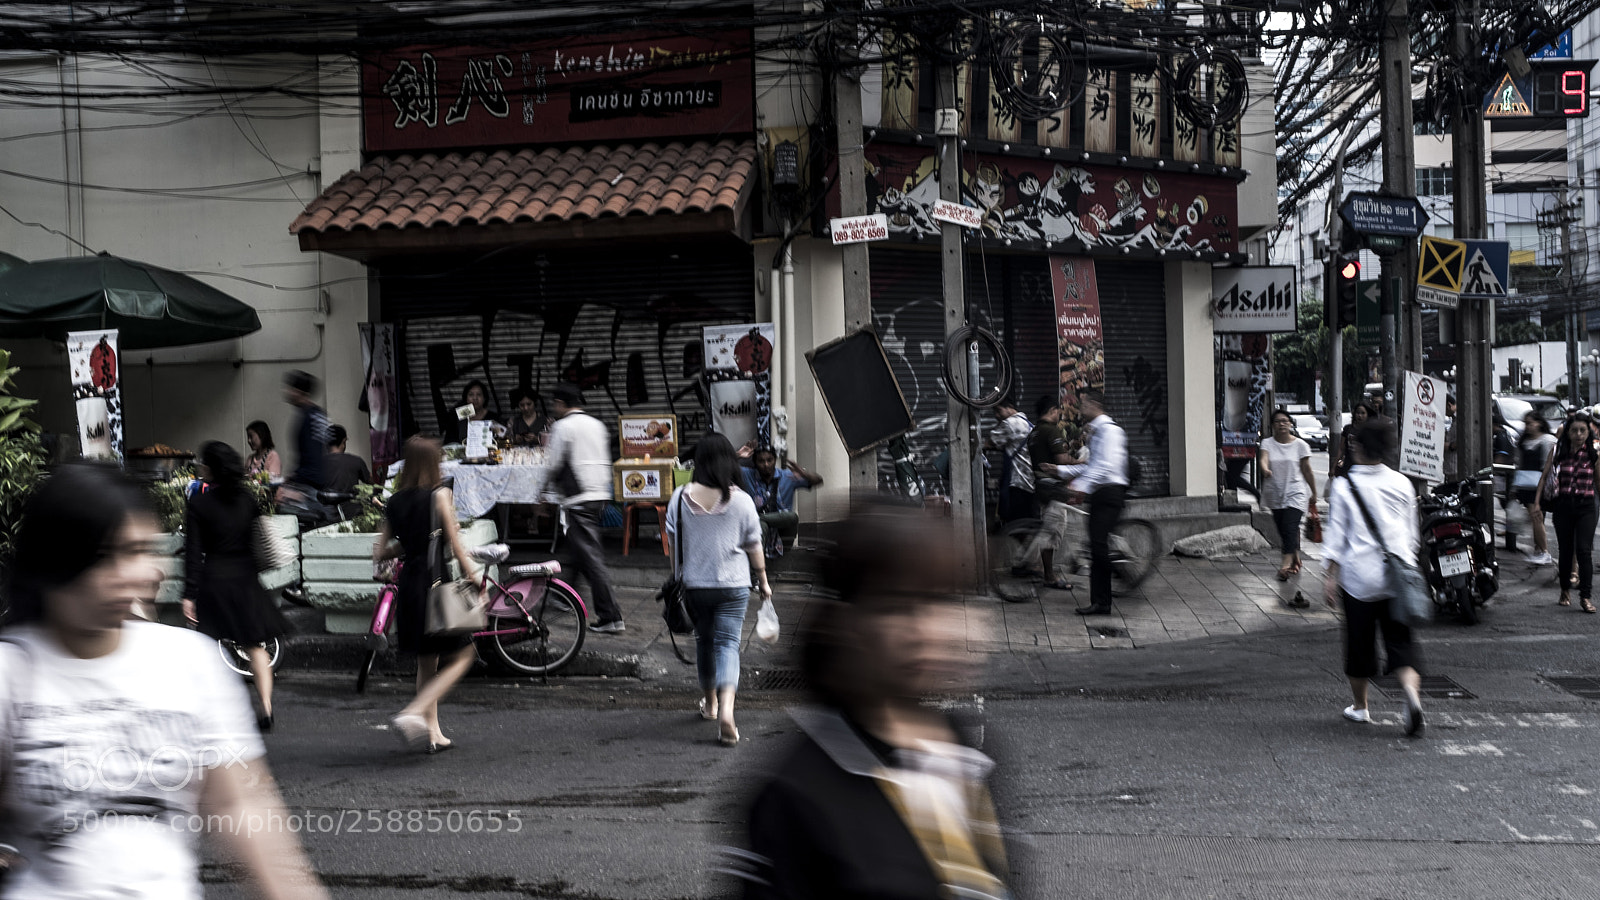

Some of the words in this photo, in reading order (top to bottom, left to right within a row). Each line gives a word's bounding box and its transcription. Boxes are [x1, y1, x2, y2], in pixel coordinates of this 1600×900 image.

[553, 45, 645, 78] Kenshin
[1561, 70, 1586, 115] 9
[1411, 206, 1417, 225] 1
[834, 227, 886, 242] 089-802-8569
[1217, 281, 1291, 311] Asahi
